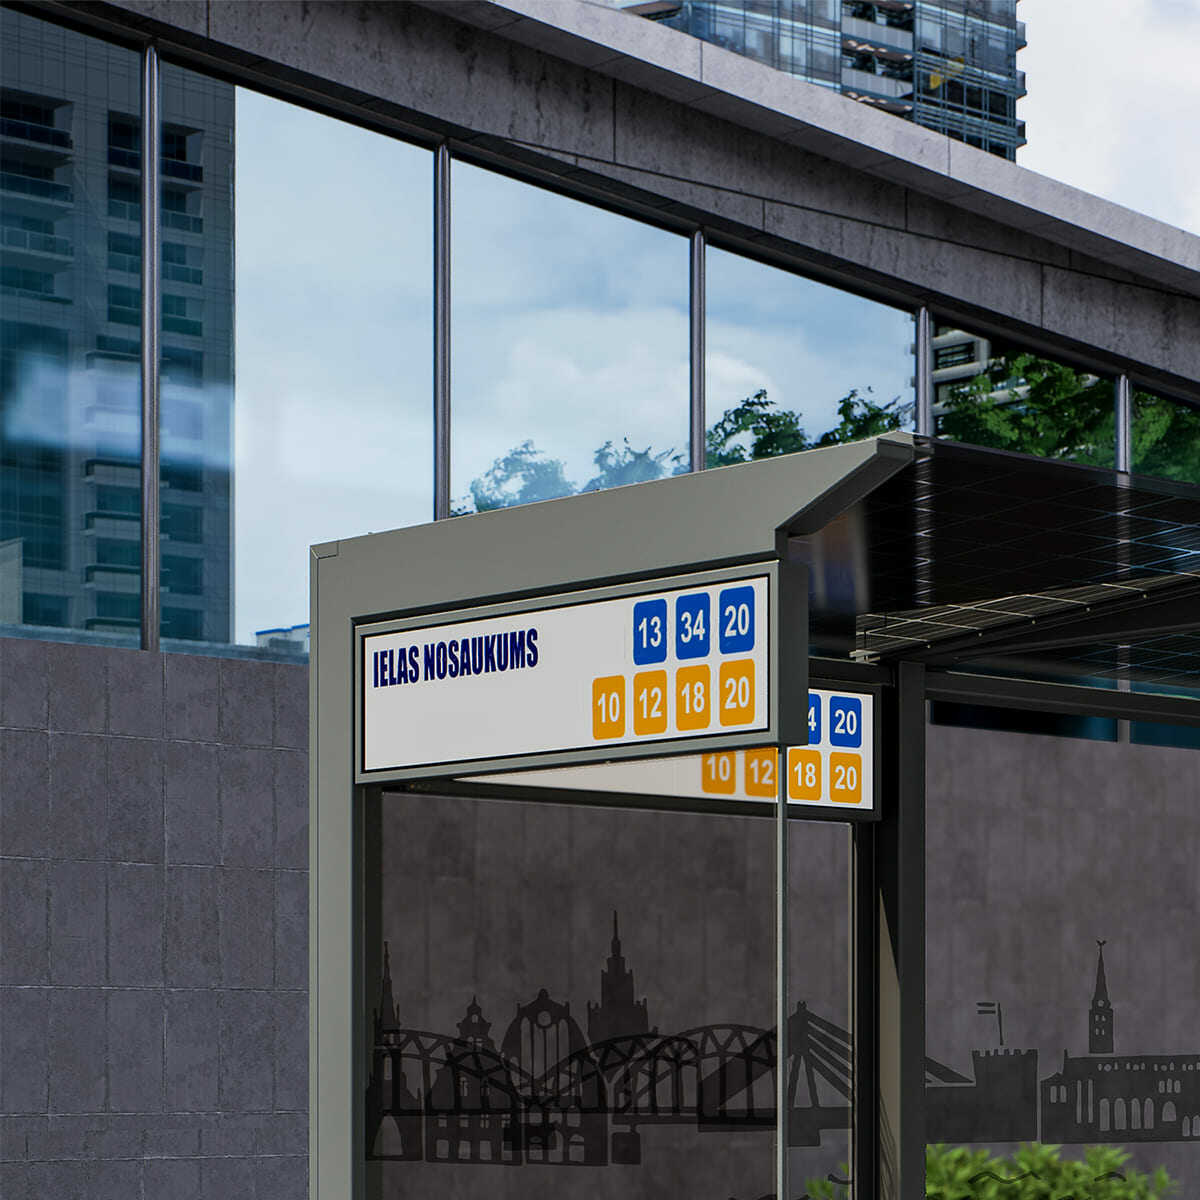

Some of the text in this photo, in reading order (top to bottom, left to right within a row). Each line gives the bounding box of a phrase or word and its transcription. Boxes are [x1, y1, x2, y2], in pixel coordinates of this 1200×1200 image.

[638, 603, 750, 649] 13 34 20
[373, 628, 539, 688] IELAS NOSAUKUMS
[598, 676, 750, 724] 10 12 18 20
[808, 706, 857, 736] 4 20
[707, 755, 857, 791] 10 12 18 20
